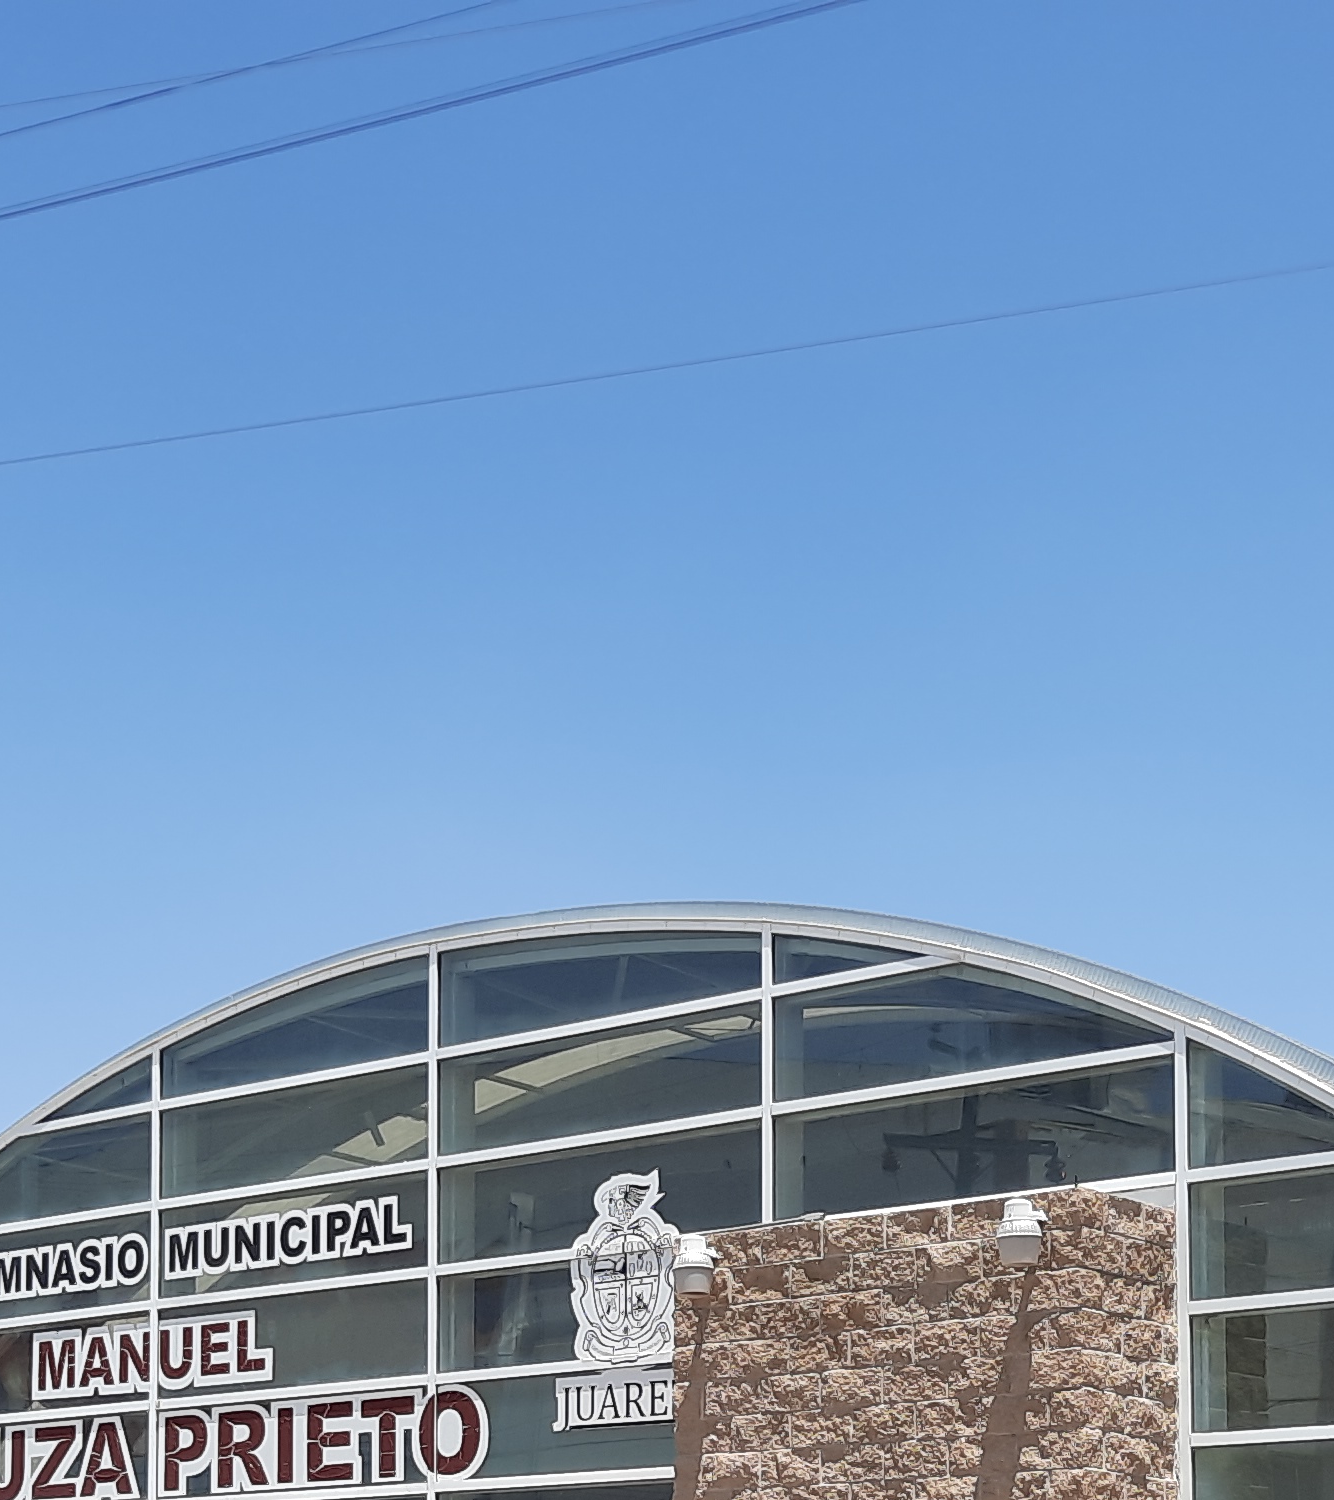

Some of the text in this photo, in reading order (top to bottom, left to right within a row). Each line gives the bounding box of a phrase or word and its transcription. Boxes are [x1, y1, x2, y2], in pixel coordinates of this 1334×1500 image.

[167, 1202, 409, 1275] MUNICIPAL
[36, 1318, 268, 1393] MANUEL
[164, 1390, 483, 1493] PRIETO
[556, 1379, 675, 1431] JUARE
